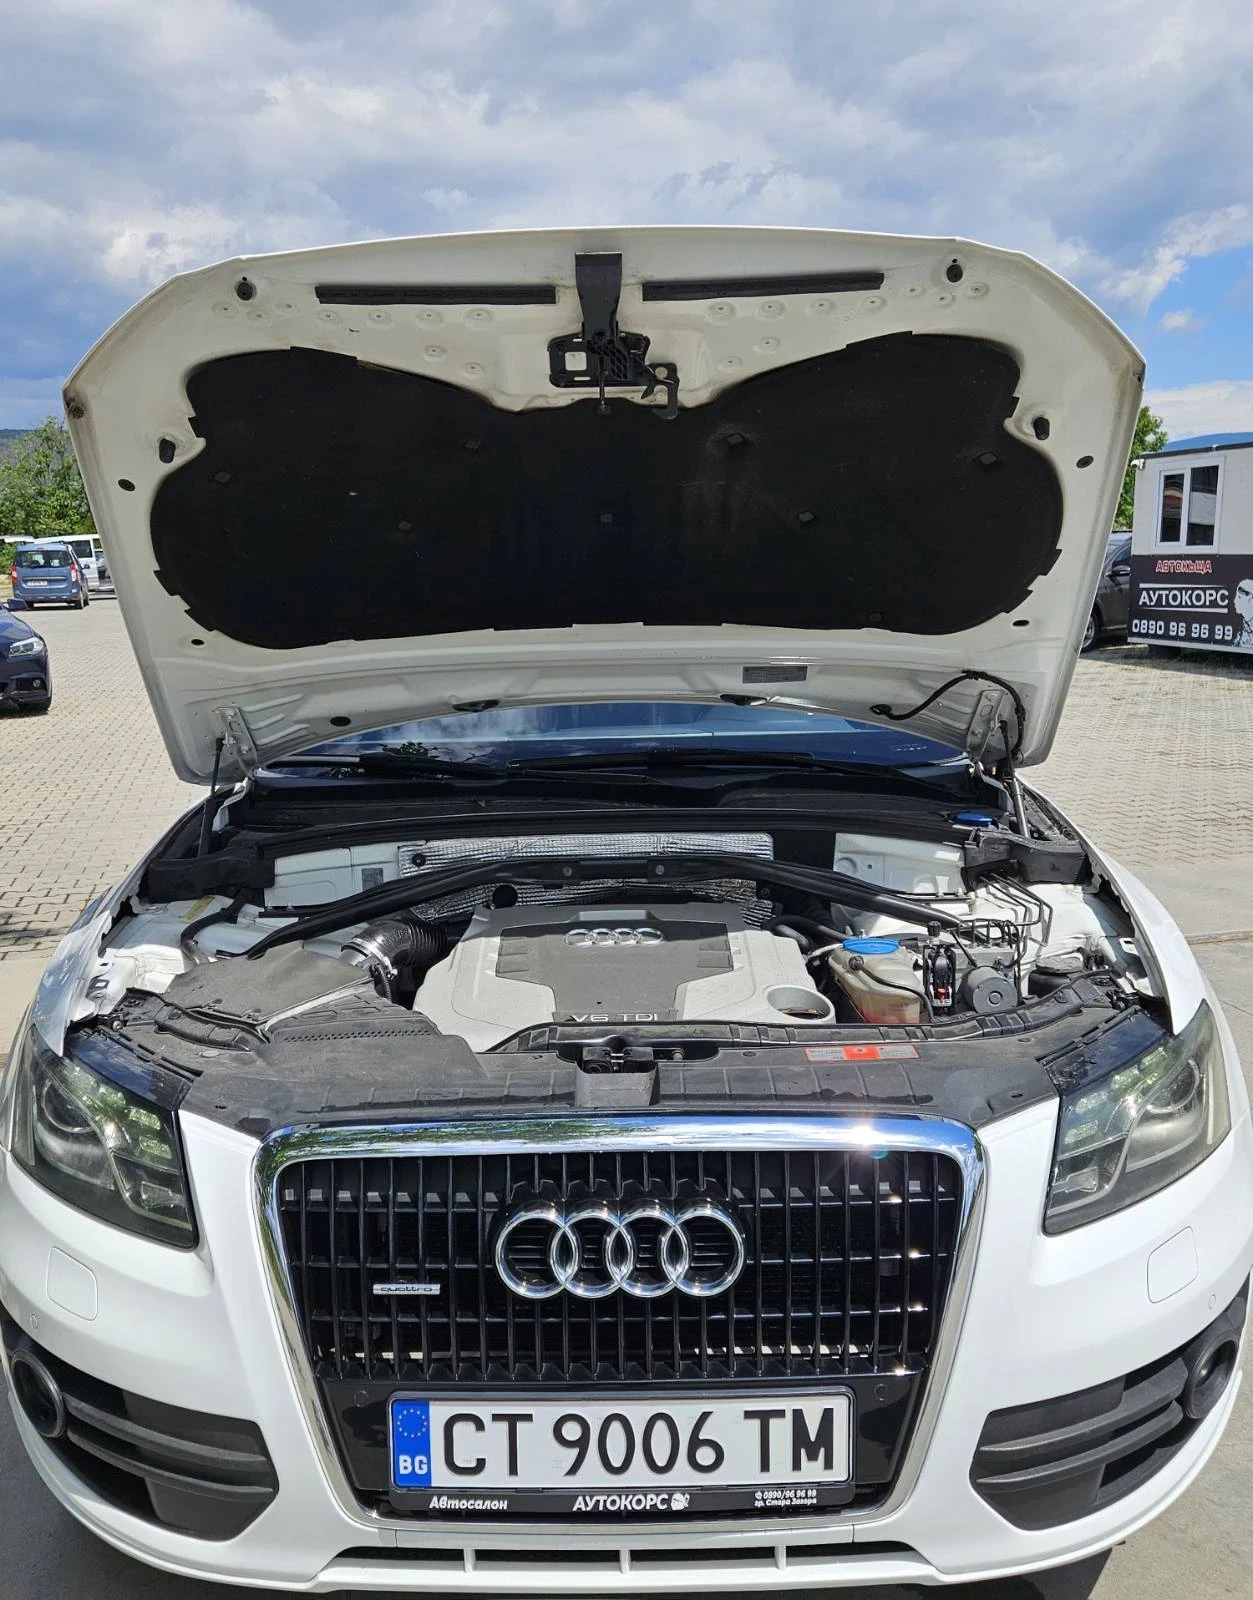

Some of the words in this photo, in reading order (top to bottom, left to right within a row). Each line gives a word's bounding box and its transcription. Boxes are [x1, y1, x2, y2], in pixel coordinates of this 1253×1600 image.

[1155, 560, 1212, 574] АВТОКЪЩА
[1138, 589, 1229, 606] АУТОКОРС
[1132, 619, 1165, 635] 0890
[1169, 621, 1186, 636] 96
[1191, 623, 1209, 638] 96
[1214, 625, 1233, 640] 99
[571, 1014, 609, 1022] V6
[616, 1013, 658, 1022] TDI
[443, 1412, 534, 1476] CT
[552, 1411, 725, 1476] 9006
[743, 1407, 834, 1473] TM
[398, 1454, 429, 1475] BG
[429, 1495, 508, 1511] Автосалон
[572, 1494, 668, 1512] АУТОКОРС
